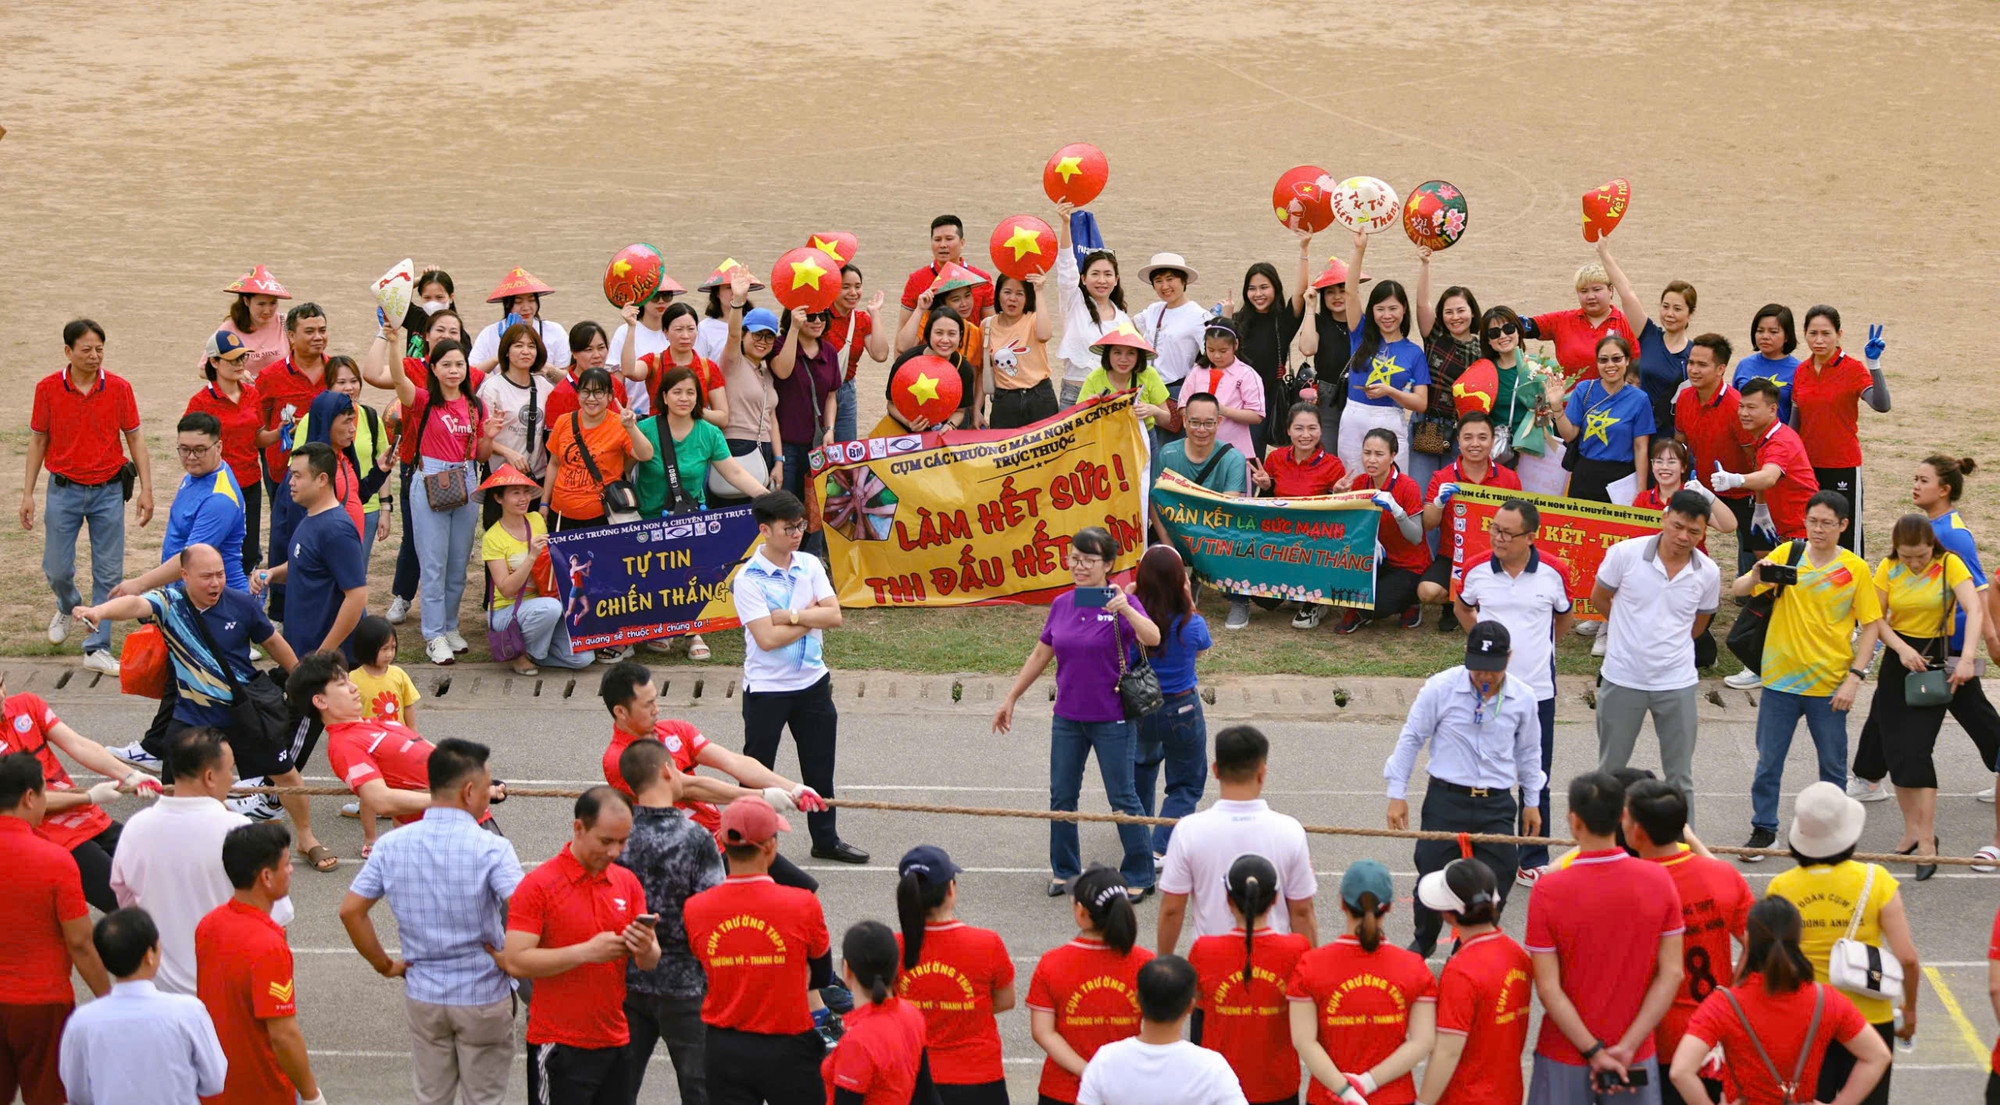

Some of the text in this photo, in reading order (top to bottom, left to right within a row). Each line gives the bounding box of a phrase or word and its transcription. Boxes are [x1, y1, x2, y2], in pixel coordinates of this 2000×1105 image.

[848, 447, 864, 458] BM
[890, 458, 922, 475] CỤM
[924, 452, 951, 469] CÁC
[1044, 420, 1073, 440] NON
[1075, 417, 1084, 428] &
[894, 453, 1130, 551] LÀM HẾT SỨC !
[1475, 489, 1491, 500] CÁC
[1548, 500, 1565, 510] NON
[568, 531, 585, 541] CÁC
[642, 522, 660, 532] NON
[1202, 506, 1233, 530] KẾT
[1236, 514, 1256, 531] LÀ
[1260, 515, 1293, 535] SỨC
[1295, 520, 1346, 542] MẠNH
[1544, 521, 1586, 546] KẾT
[622, 548, 691, 578] TỰ TIN
[865, 572, 927, 605] THI
[929, 543, 1006, 596] ĐẤU
[1012, 518, 1073, 579] HẾT
[1205, 538, 1233, 557] TIN
[1235, 537, 1255, 560] LÀ
[1259, 540, 1311, 566] CHIẾN
[1315, 545, 1375, 573] THẮNG
[595, 575, 729, 618] CHIẾN THẮNG
[585, 635, 611, 646] quang
[666, 621, 690, 632] chúng
[693, 620, 703, 628] ta
[1481, 639, 1493, 652] F
[766, 926, 787, 953] THPT
[1229, 964, 1276, 984] TRỜNG
[1686, 945, 1717, 1004] 8
